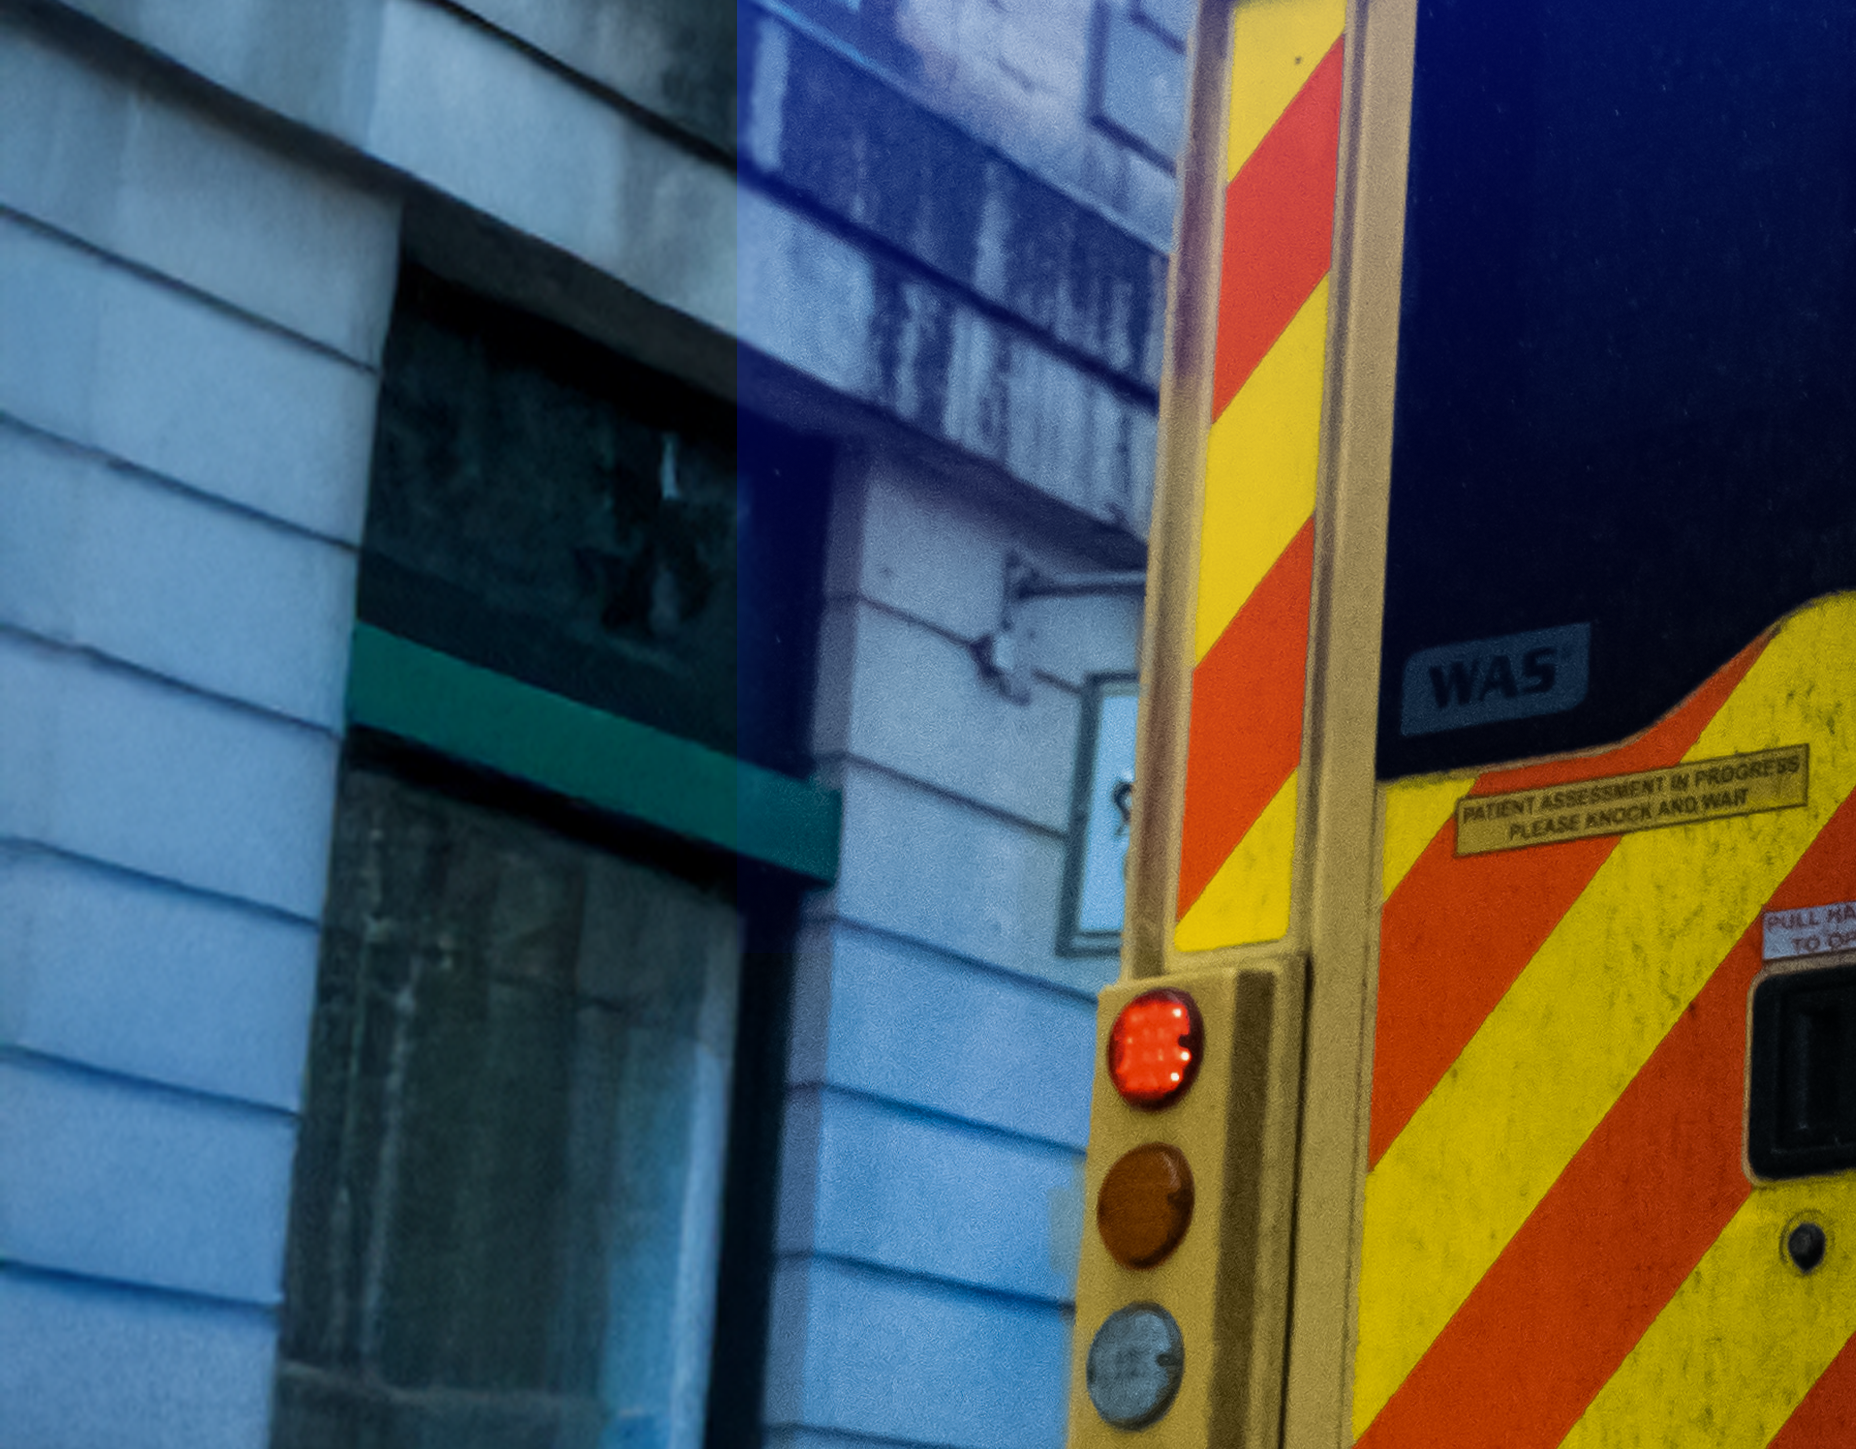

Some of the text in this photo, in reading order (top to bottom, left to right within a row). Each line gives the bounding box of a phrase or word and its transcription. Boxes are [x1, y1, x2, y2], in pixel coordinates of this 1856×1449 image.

[1428, 646, 1558, 709] WAS
[1463, 753, 1802, 825] PATIENT ASSESSMENT IN PROGRESS
[1510, 787, 1749, 841] PLEASE KNOCK AND WAIT
[1767, 910, 1820, 931] PULL
[1792, 936, 1822, 954] TO
